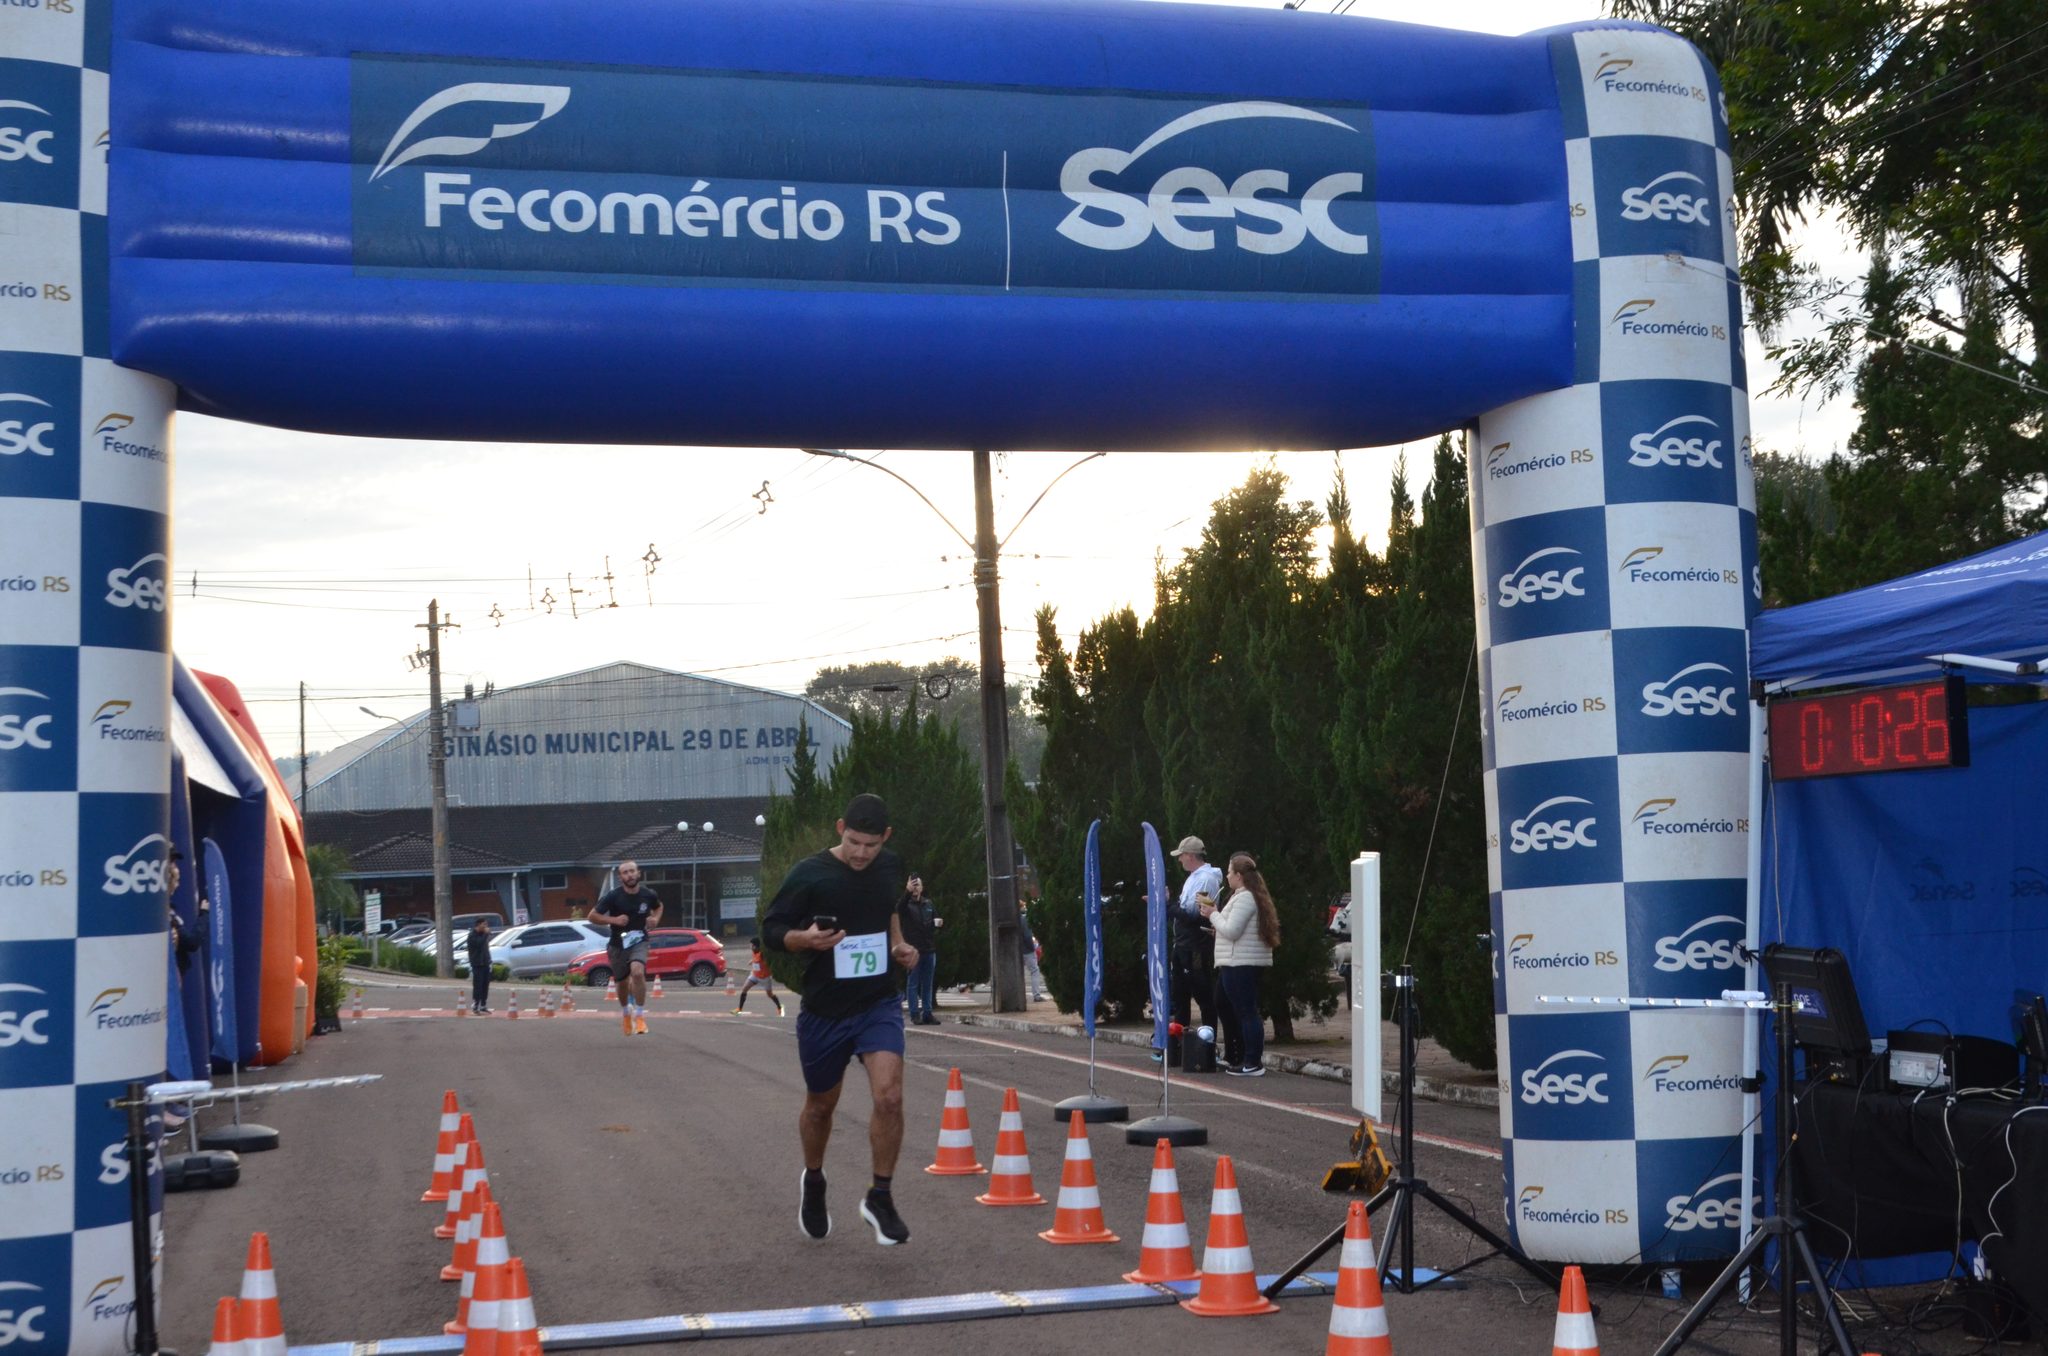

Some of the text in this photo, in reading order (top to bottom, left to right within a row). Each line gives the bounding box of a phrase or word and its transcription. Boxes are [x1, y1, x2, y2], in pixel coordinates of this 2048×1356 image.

[1605, 79, 1706, 102] Fecomércio RS
[424, 147, 1368, 254] Fecomércio RS Sesc
[1620, 187, 1710, 226] Sesc
[44, 284, 71, 301] RS
[1622, 319, 1726, 340] Fecomércio RS
[1628, 432, 1722, 469] Sesc
[1490, 448, 1594, 480] Fecomércio RS
[43, 576, 70, 592] RS
[1498, 566, 1585, 608] Sesc
[1631, 567, 1720, 583] Fecomércio
[1723, 568, 1738, 584] RS
[1501, 701, 1577, 723] Fecomércio
[1582, 697, 1606, 714] RS
[1641, 682, 1736, 717] Sesc
[444, 727, 820, 757] GINÁSIO MUNICIPAL 29 DE ABRL
[1510, 817, 1597, 854] Sesc
[1643, 818, 1734, 834] Fecomércio
[41, 869, 67, 886] RS
[850, 951, 877, 975] 79
[1512, 952, 1589, 969] Fecomércio
[1594, 950, 1618, 966] RS
[1520, 1069, 1608, 1104] Sesc
[38, 1164, 65, 1183] RS
[1523, 1206, 1600, 1224] Fecomércio
[1605, 1208, 1629, 1225] RS
